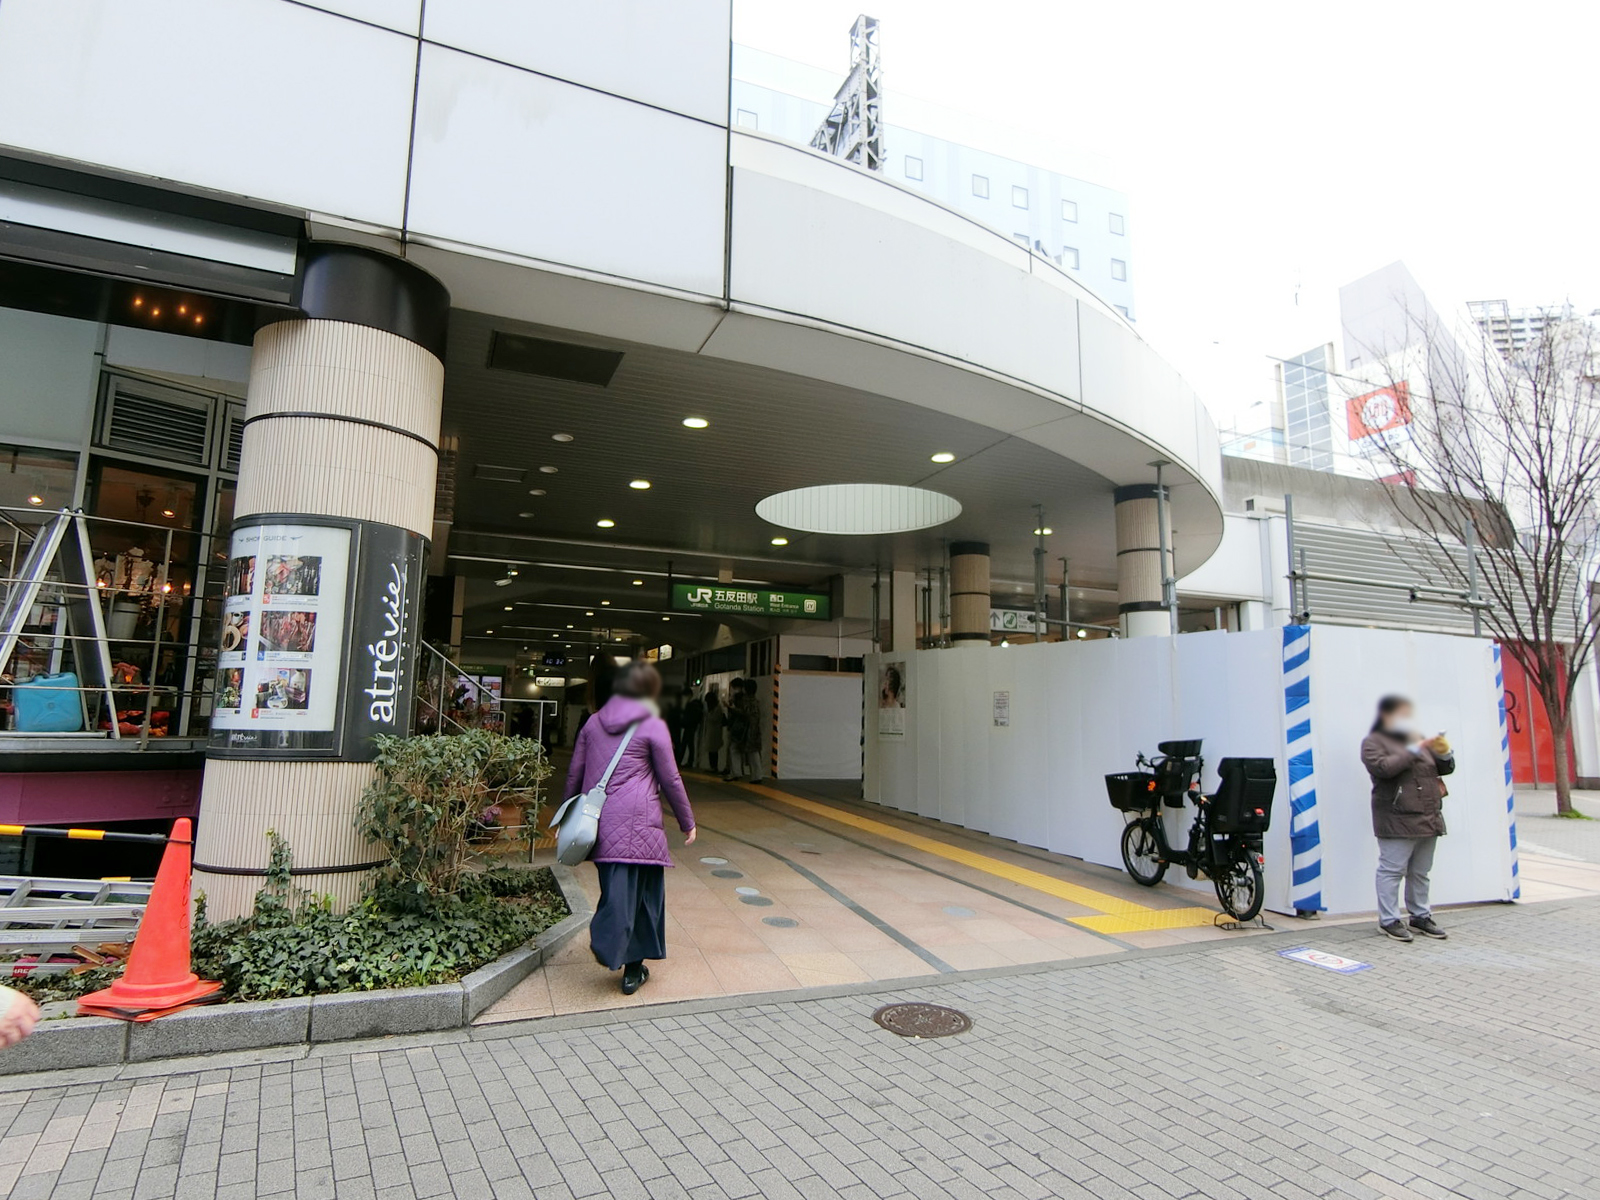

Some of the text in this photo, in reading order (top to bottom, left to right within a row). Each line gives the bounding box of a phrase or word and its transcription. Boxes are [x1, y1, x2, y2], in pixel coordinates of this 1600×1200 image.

[687, 588, 712, 603] JR
[714, 590, 758, 604] 五反田駅
[714, 602, 741, 611] Gotanda
[742, 604, 765, 612] Station
[364, 562, 402, 723] atrévie
